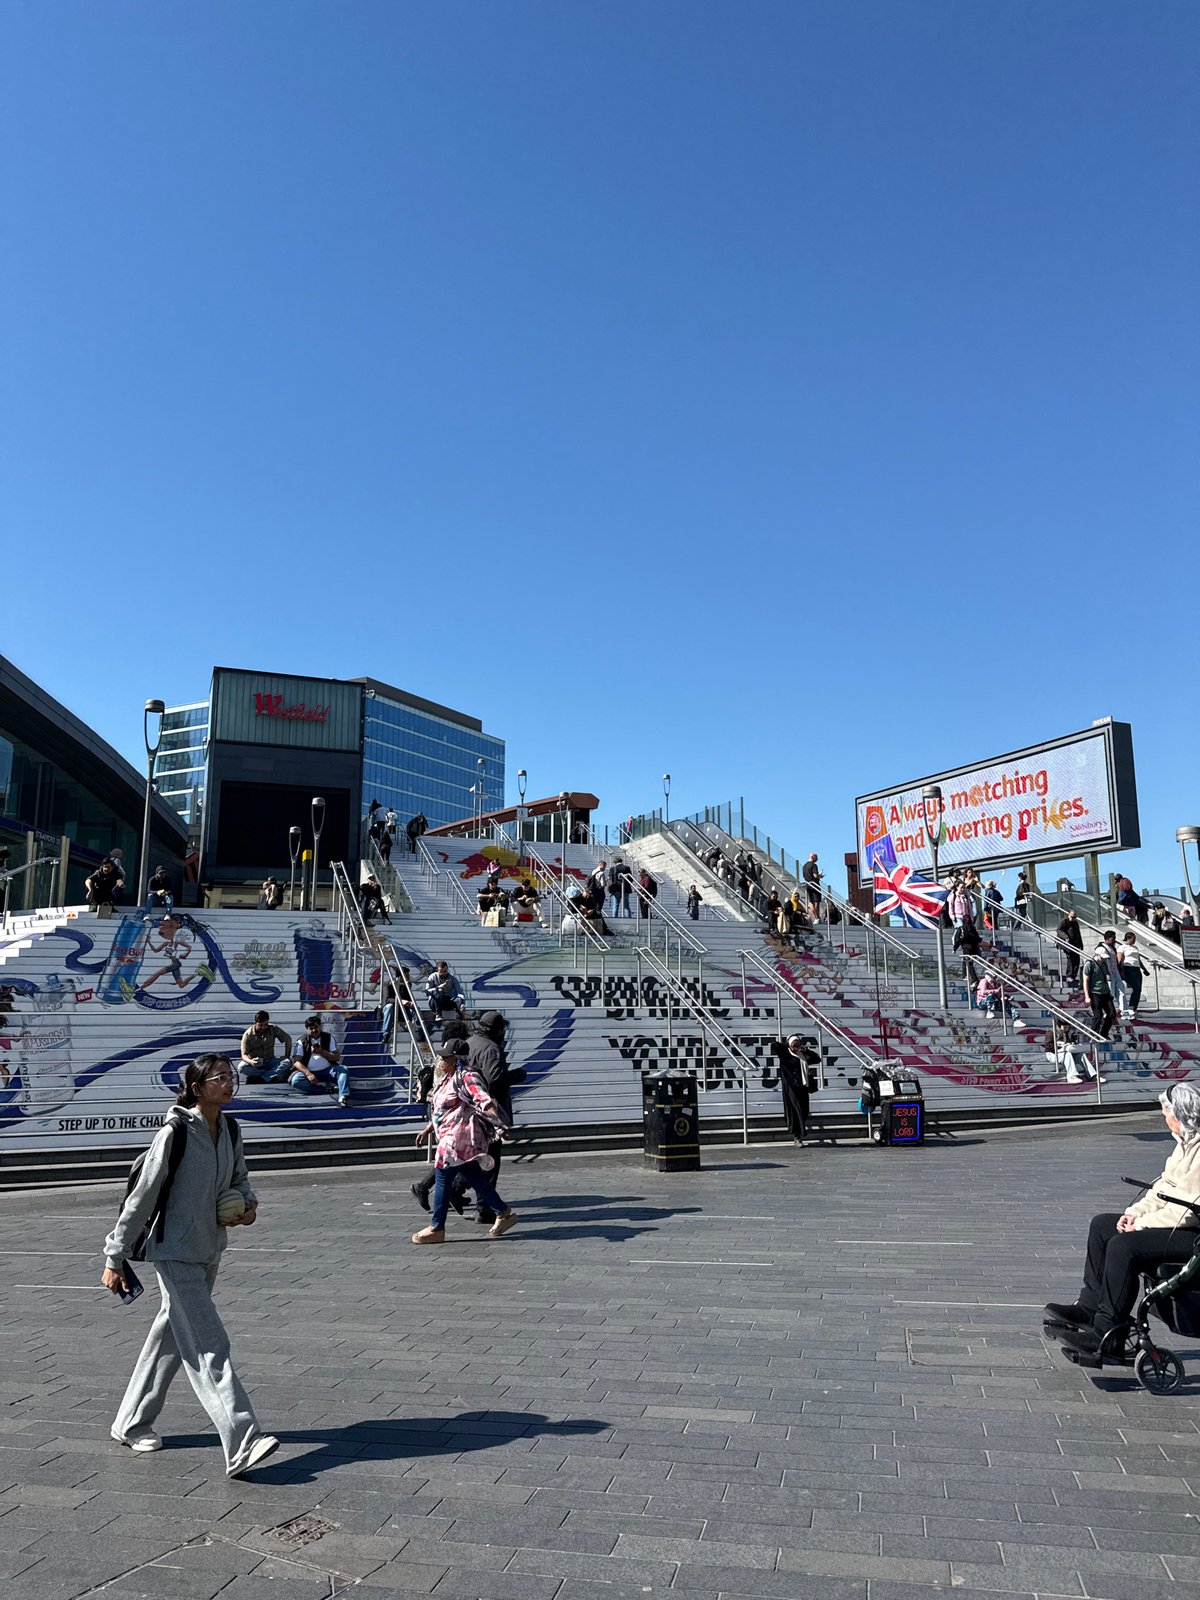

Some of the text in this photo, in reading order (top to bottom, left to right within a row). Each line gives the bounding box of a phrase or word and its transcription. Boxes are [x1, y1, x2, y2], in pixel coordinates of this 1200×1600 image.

[253, 692, 331, 723] Westfield
[950, 770, 1048, 807] matching
[895, 830, 925, 854] and
[77, 992, 91, 1001] NEW
[893, 1108, 917, 1117] JESUS
[59, 1118, 82, 1131] STEP
[85, 1118, 100, 1130] UP
[102, 1117, 116, 1129] TO
[119, 1116, 137, 1129] THE
[900, 1118, 908, 1127] IS
[895, 1128, 914, 1137] LORD
